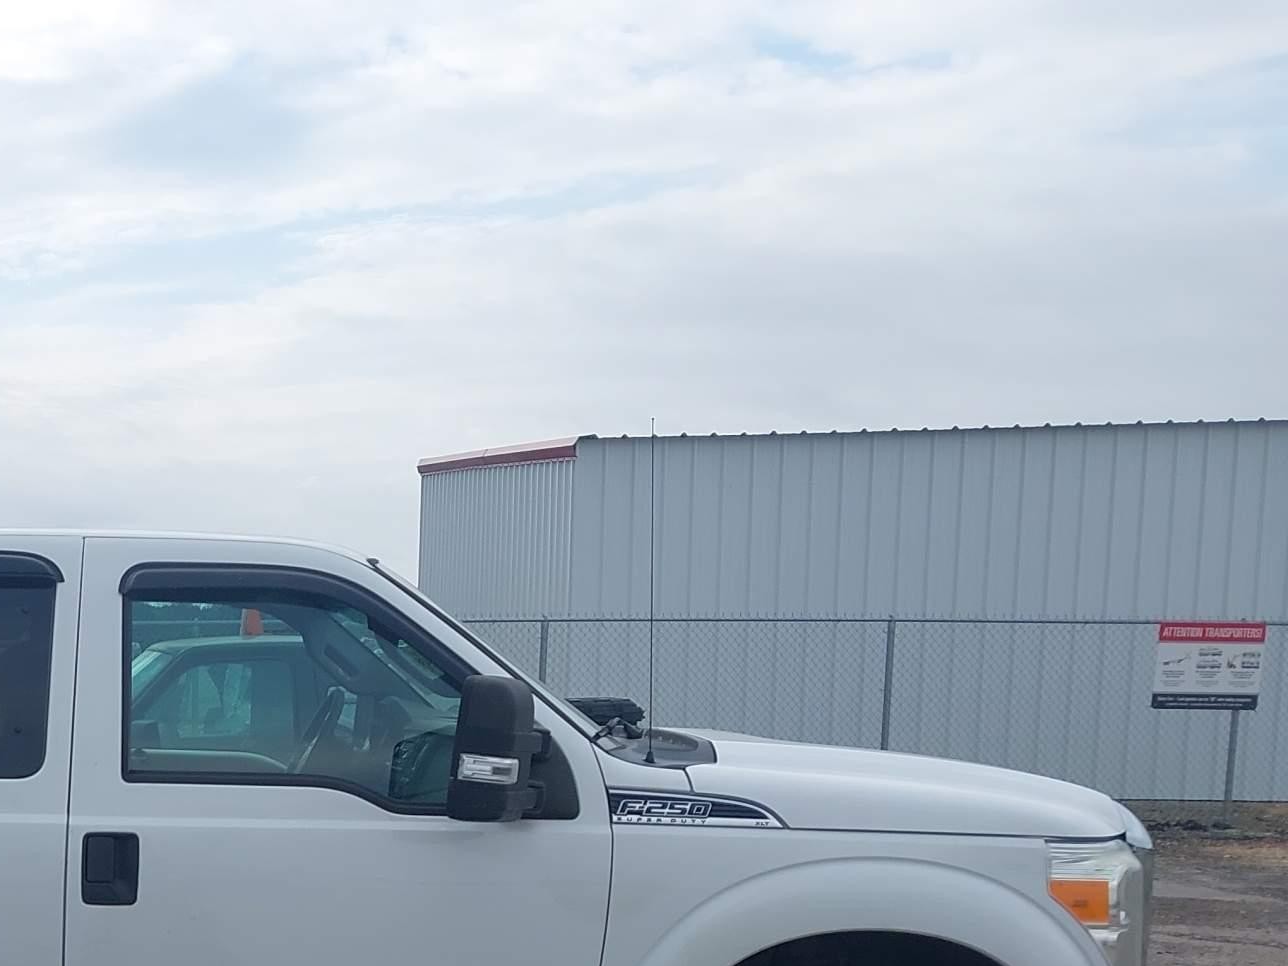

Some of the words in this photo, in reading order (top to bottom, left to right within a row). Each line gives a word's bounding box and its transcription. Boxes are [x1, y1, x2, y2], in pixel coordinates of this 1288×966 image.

[1162, 627, 1203, 638] ATTENTION
[616, 799, 713, 818] F-250
[617, 816, 664, 824] SUPER
